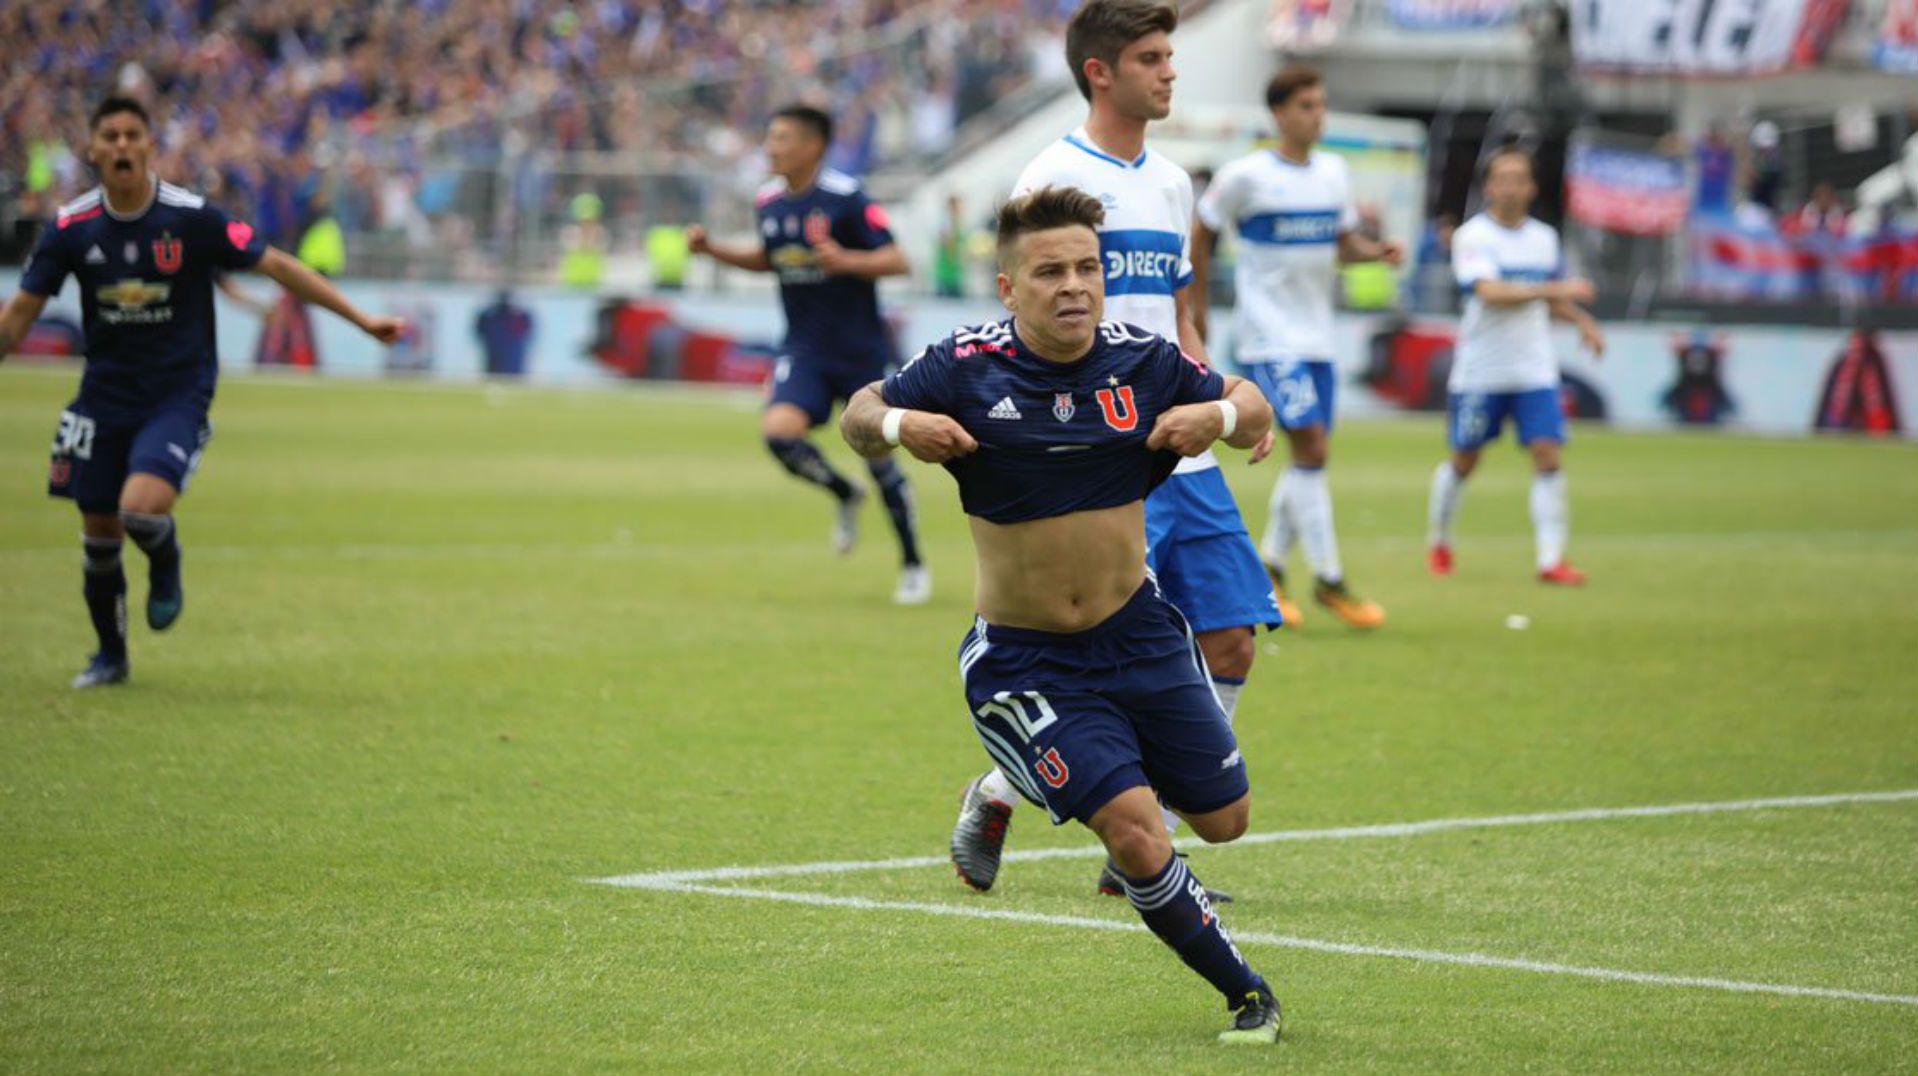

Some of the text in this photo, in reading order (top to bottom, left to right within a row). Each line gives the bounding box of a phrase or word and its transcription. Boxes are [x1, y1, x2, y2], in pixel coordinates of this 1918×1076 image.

[152, 239, 182, 273] U
[988, 410, 1022, 420] adidas
[1096, 385, 1139, 432] U
[977, 690, 1058, 744] 10
[1035, 747, 1069, 788] U
